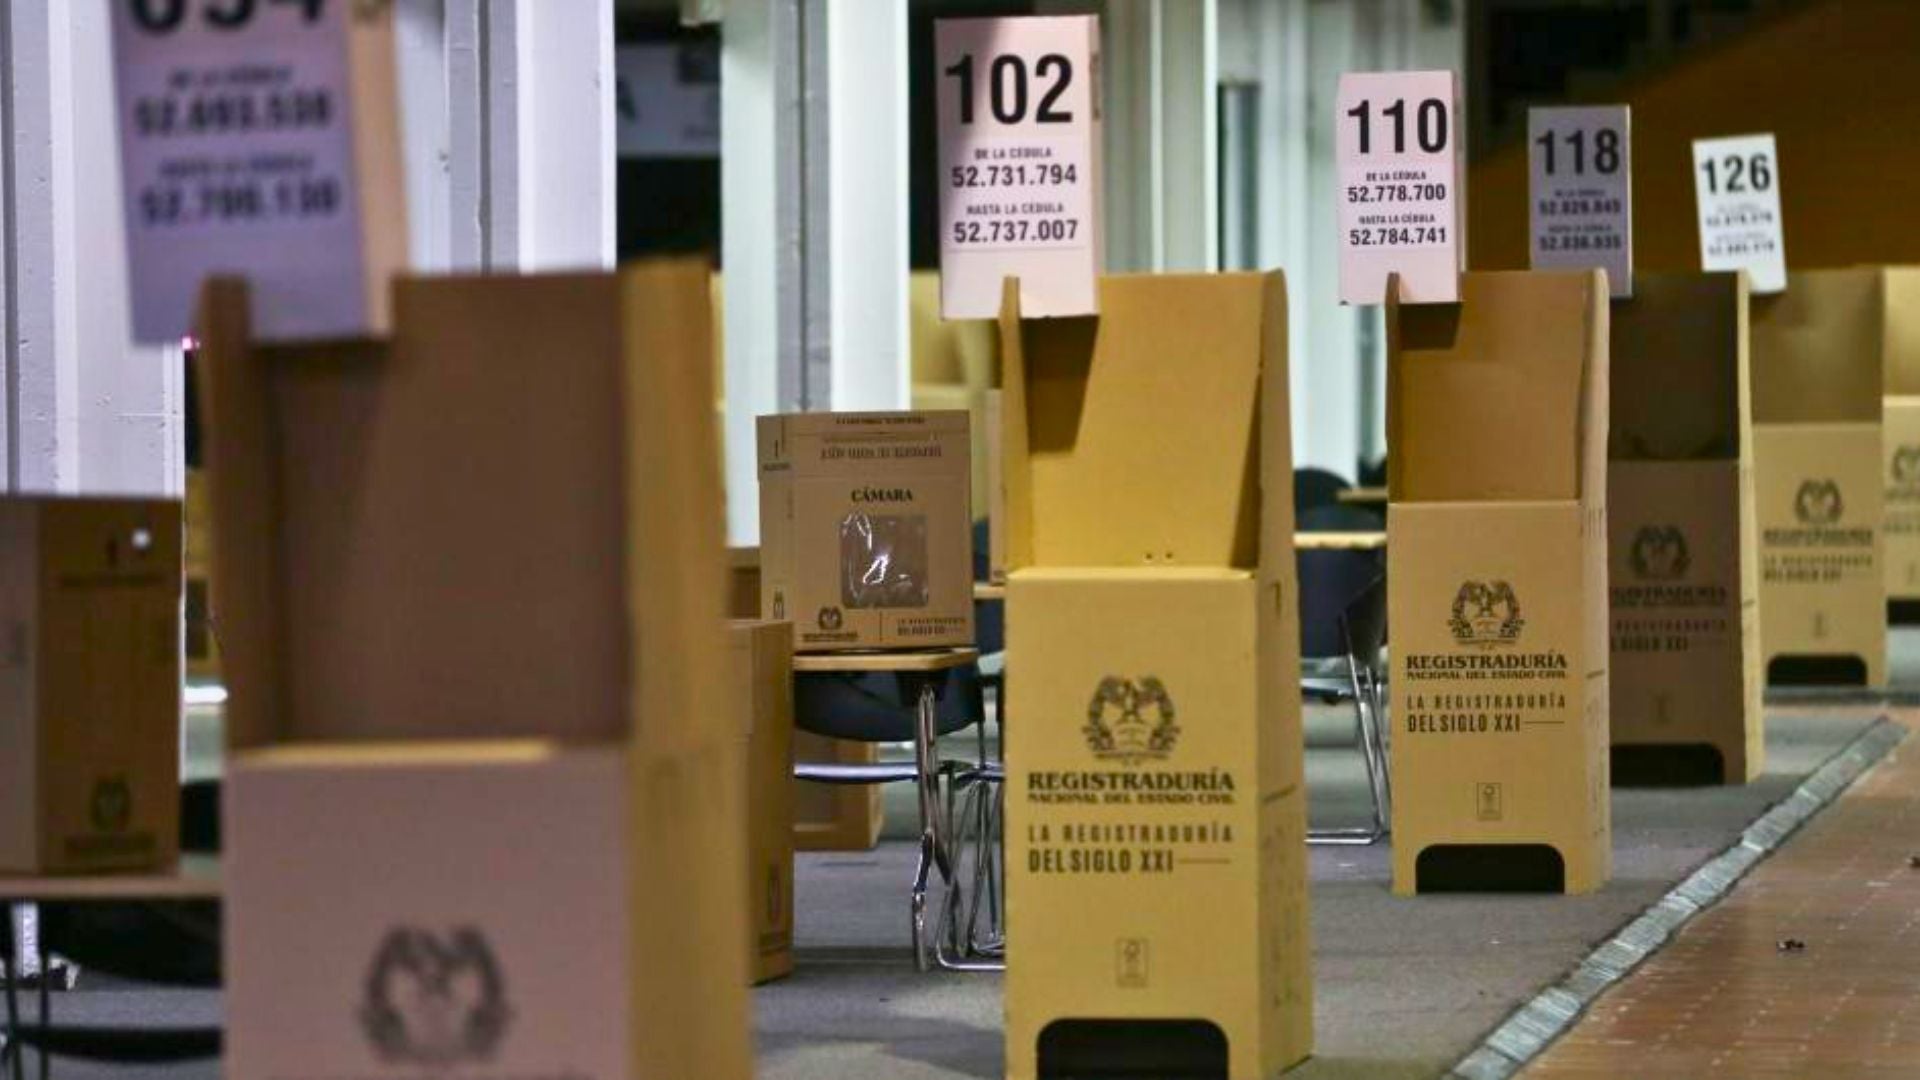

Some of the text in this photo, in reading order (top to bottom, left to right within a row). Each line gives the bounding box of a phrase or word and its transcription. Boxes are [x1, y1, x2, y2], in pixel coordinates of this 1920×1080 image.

[945, 54, 1073, 124] 102
[1347, 98, 1448, 154] 110
[993, 147, 1005, 159] LA
[1536, 129, 1620, 175] 118
[952, 164, 1077, 188] 52.731.794
[1380, 172, 1391, 180] LA
[1701, 153, 1771, 194] 126
[1347, 183, 1447, 203] 52.778.700
[1005, 203, 1018, 214] LA
[1389, 214, 1400, 224] LA
[953, 219, 1079, 243] 52.737.007
[1349, 226, 1447, 246] 52.784.741
[851, 487, 914, 502] CÁMARA
[1406, 651, 1568, 669] REGISTRADURÍA
[1407, 692, 1566, 710] LA REGISTRADURÍA
[1408, 714, 1521, 732] DEL SIGLO XXI
[1027, 766, 1235, 791] REGISTRADURÍA
[1028, 821, 1232, 843] LA REGISTRADURÍA
[1028, 849, 1174, 873] DEL SIGLO XXI
